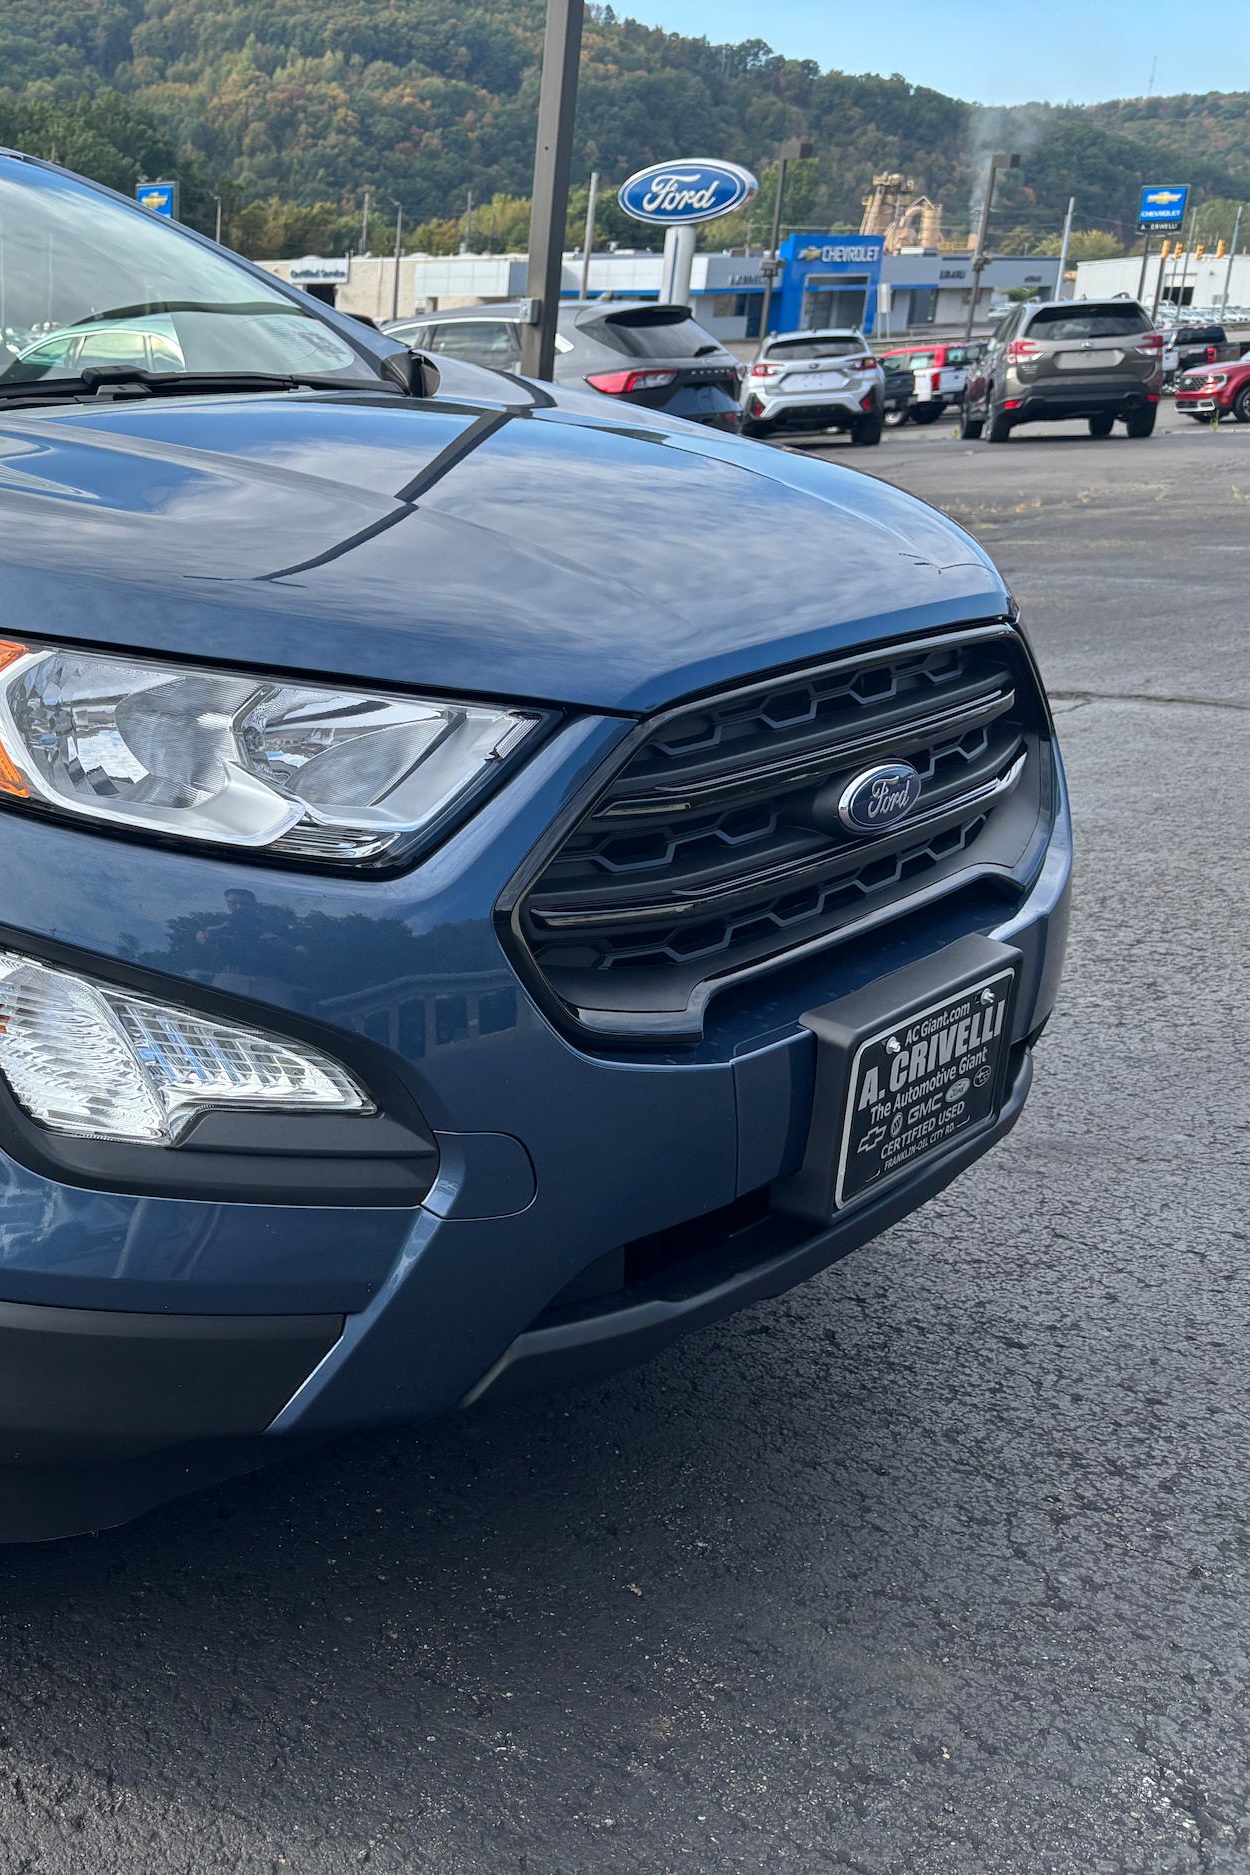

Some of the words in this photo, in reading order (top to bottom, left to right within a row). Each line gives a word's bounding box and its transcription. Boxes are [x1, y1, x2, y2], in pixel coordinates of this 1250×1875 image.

[642, 173, 720, 212] Ford
[821, 246, 879, 263] CHEVROLET
[868, 776, 910, 818] Ford
[857, 1066, 886, 1111] A.
[889, 999, 1005, 1092] CRIVELLI
[870, 1102, 891, 1125] The
[893, 1065, 956, 1113] Automotive
[958, 1047, 988, 1075] Giant
[907, 1092, 943, 1125] GMC
[880, 1117, 936, 1160] CERTIFIED
[938, 1100, 966, 1126] USED
[930, 1128, 946, 1144] CITY
